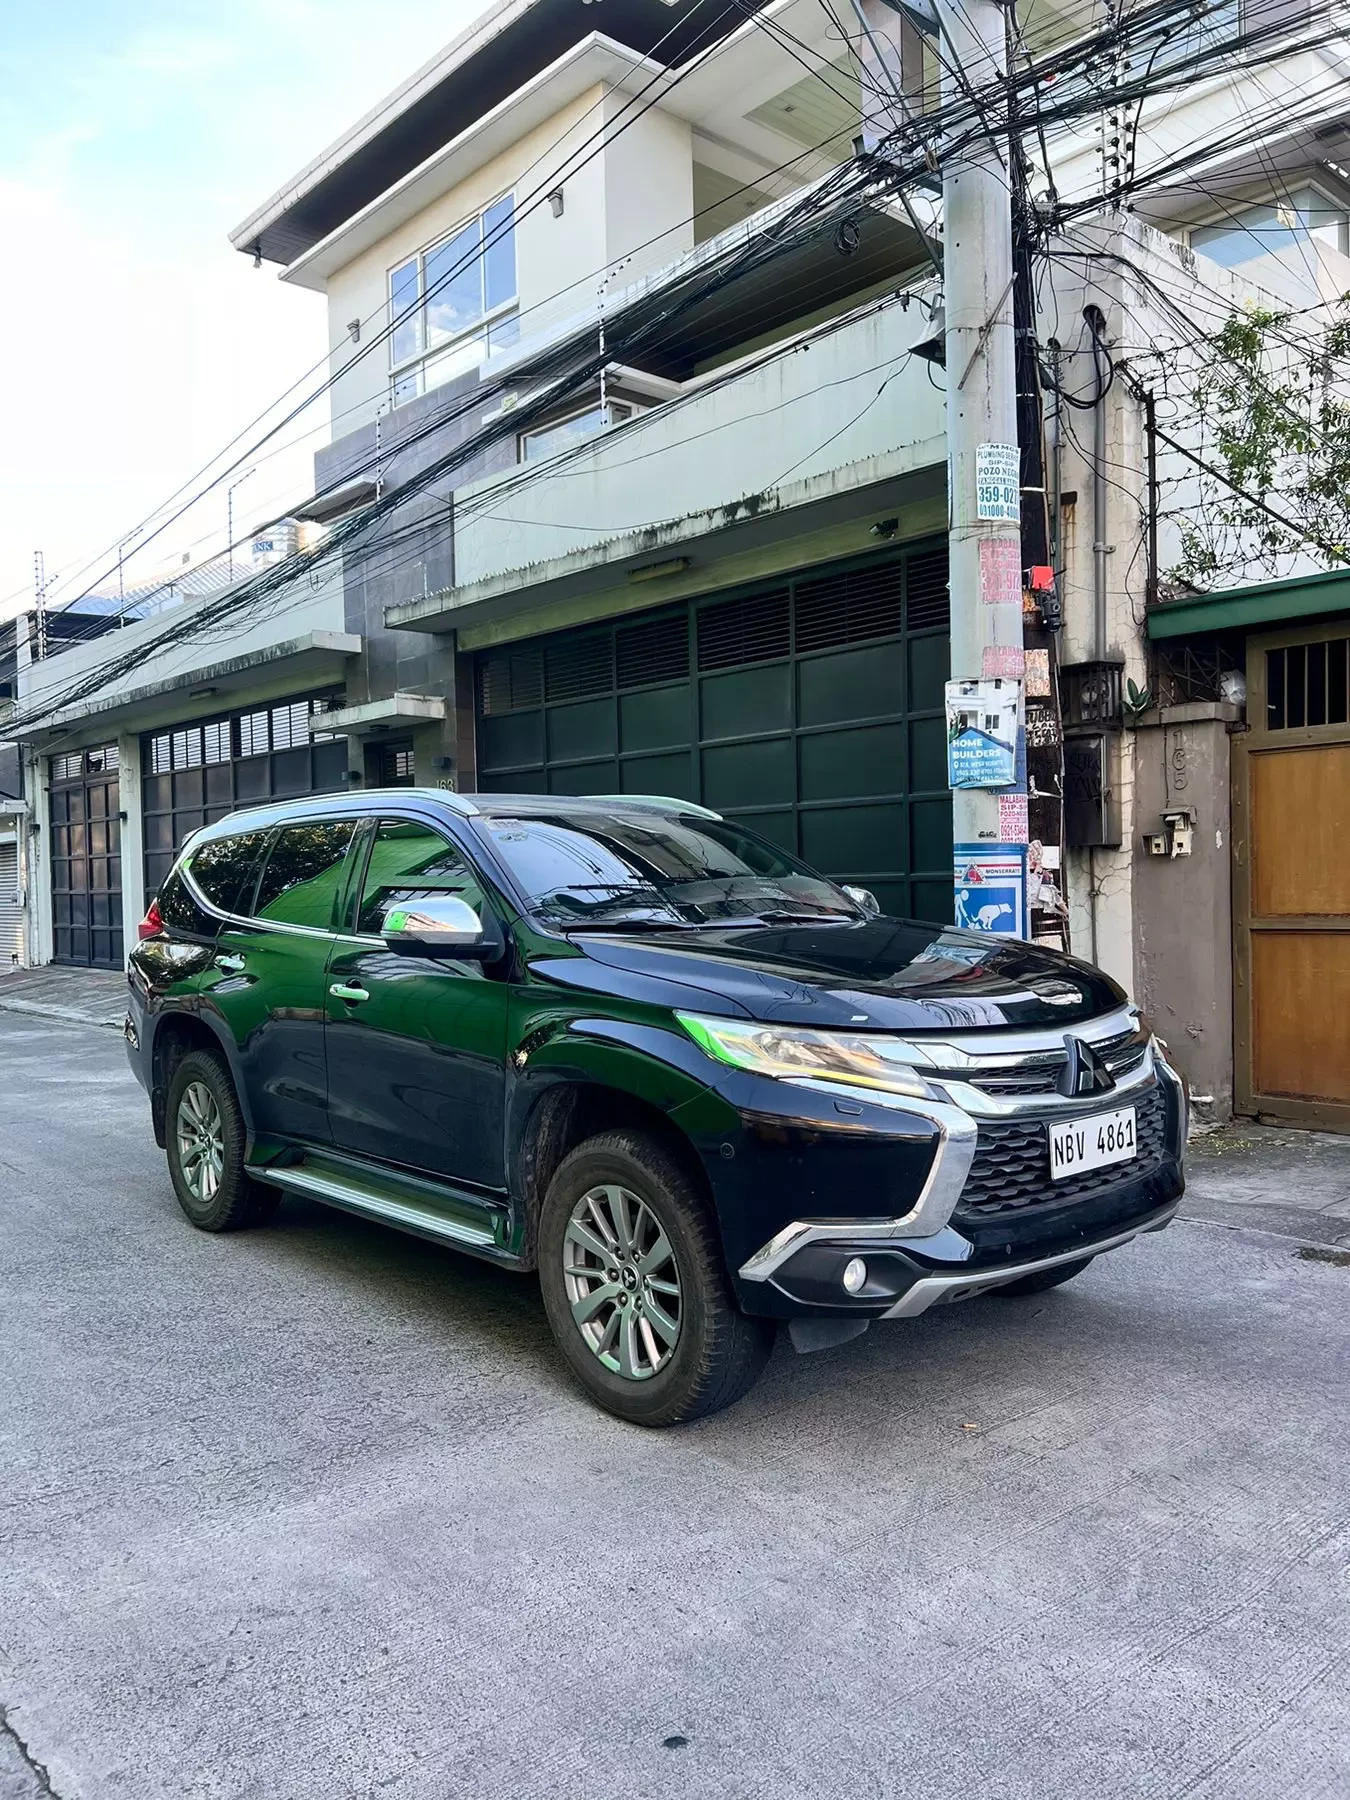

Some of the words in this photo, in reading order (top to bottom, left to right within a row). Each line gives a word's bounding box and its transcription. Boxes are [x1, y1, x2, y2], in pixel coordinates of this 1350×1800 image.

[978, 467, 1001, 476] POZO
[952, 739, 983, 748] HOME
[952, 749, 1001, 759] BUILDERS
[1172, 729, 1188, 790] 165
[1054, 1131, 1085, 1167] NBV
[1097, 1119, 1134, 1155] 4861
